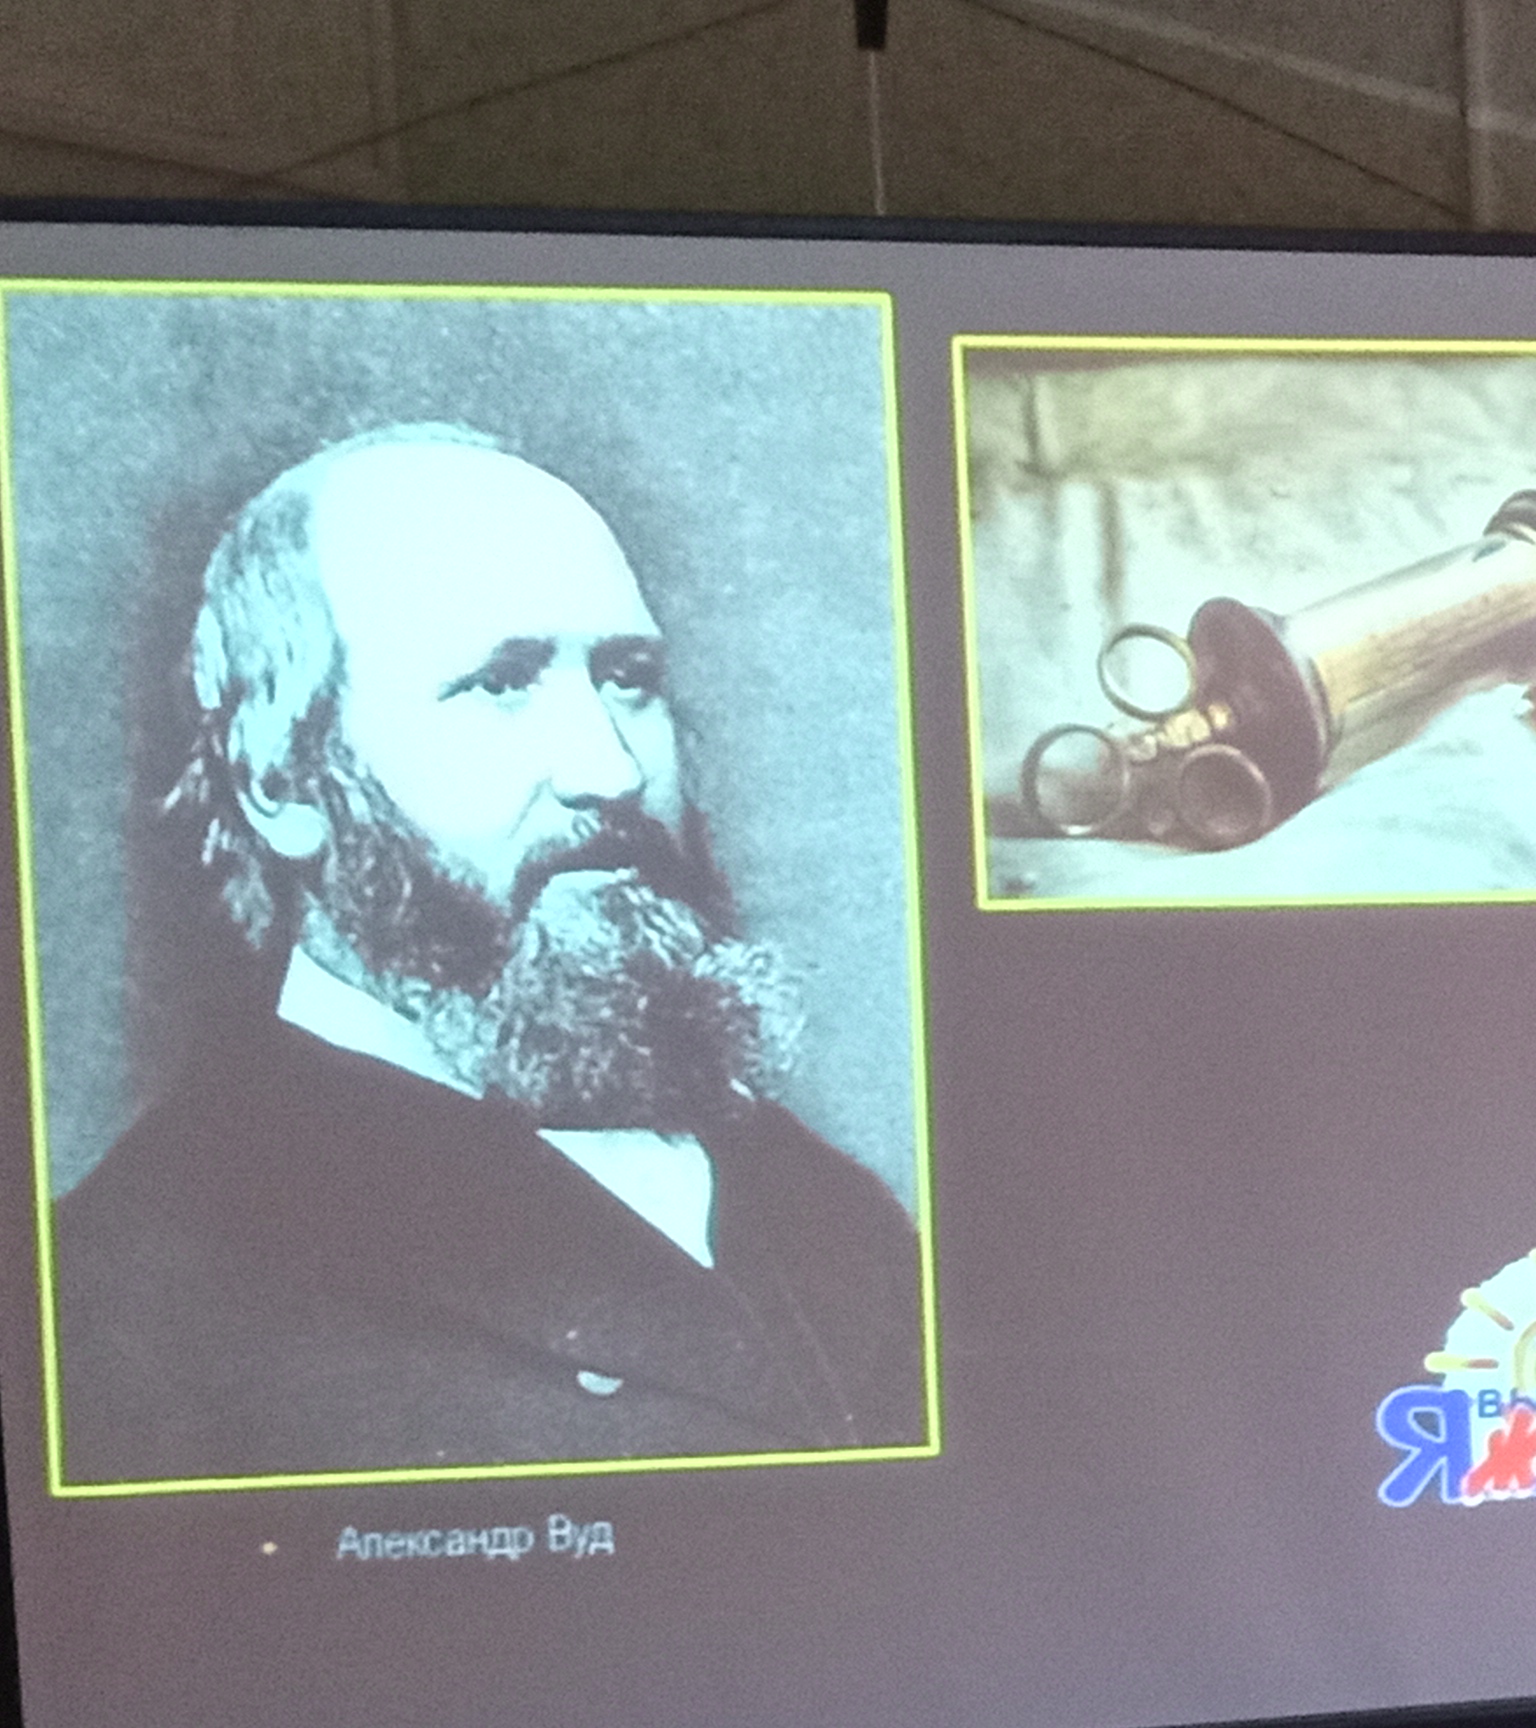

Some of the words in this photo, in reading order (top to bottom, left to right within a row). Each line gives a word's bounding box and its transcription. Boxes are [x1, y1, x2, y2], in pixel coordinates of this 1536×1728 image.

[1376, 1384, 1474, 1507] Я
[336, 1525, 535, 1560] Александр
[546, 1514, 615, 1559] Вуд
